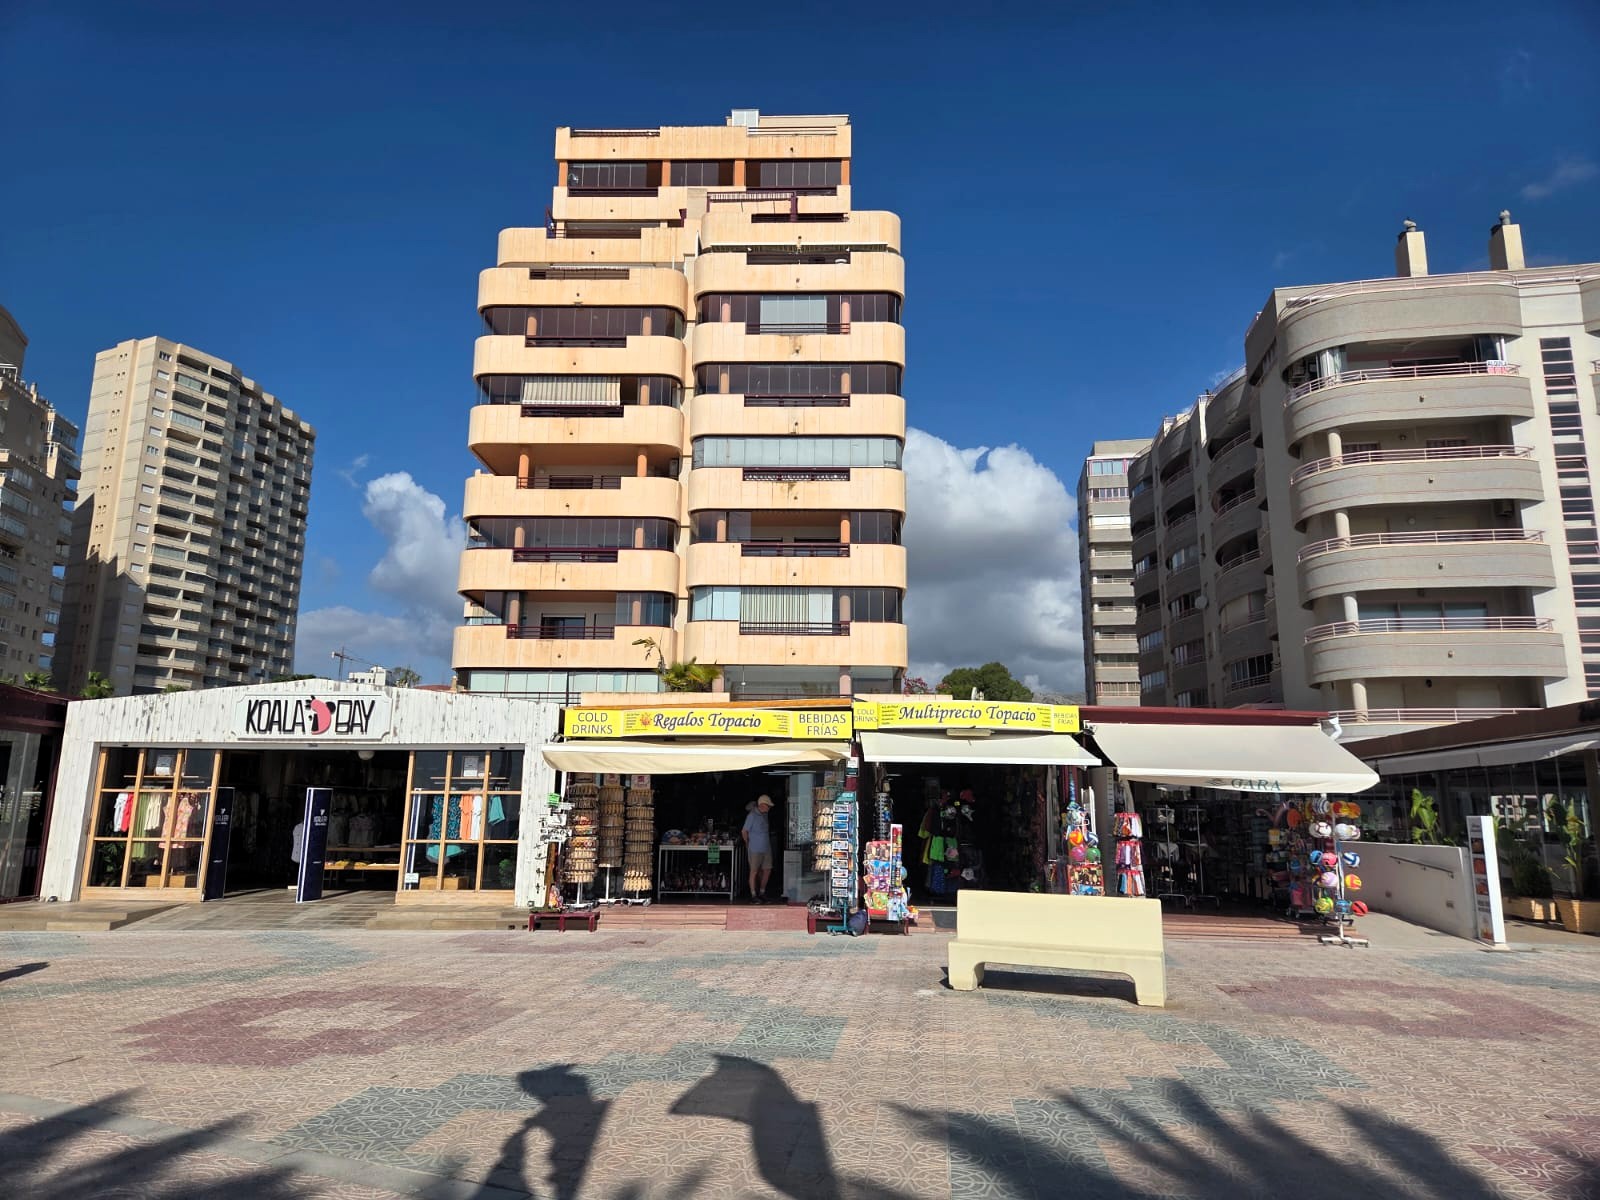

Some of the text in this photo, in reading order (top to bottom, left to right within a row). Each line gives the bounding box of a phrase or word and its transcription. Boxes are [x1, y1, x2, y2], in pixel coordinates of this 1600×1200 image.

[246, 699, 375, 734] KOALA BAY
[577, 712, 608, 722] COLD
[799, 713, 846, 724] BEBIDAS
[899, 704, 982, 723] Multiprecio
[985, 705, 1036, 724] Topacio
[653, 711, 704, 731] Regalos
[708, 712, 761, 731] Topacio
[572, 724, 613, 734] DRINKS
[1231, 778, 1281, 791] GARA
